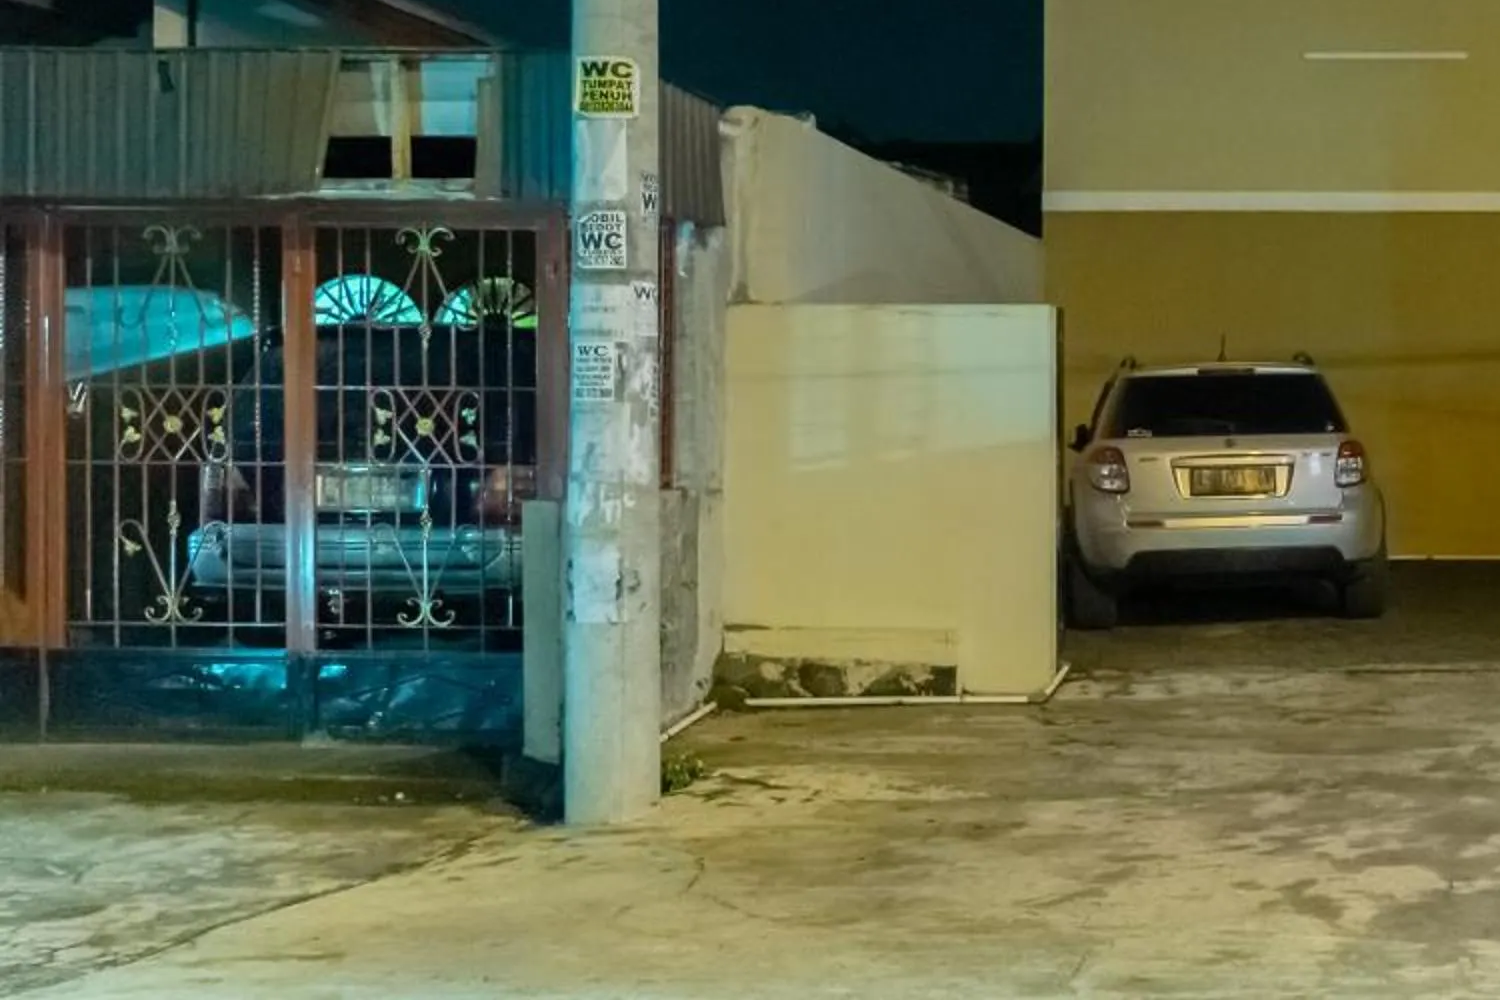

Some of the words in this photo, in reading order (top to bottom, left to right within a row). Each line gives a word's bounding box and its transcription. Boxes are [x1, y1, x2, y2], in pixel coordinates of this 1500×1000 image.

[581, 61, 633, 78] WC
[588, 213, 624, 223] OBIL
[581, 232, 623, 249] WC
[577, 345, 608, 357] WC
